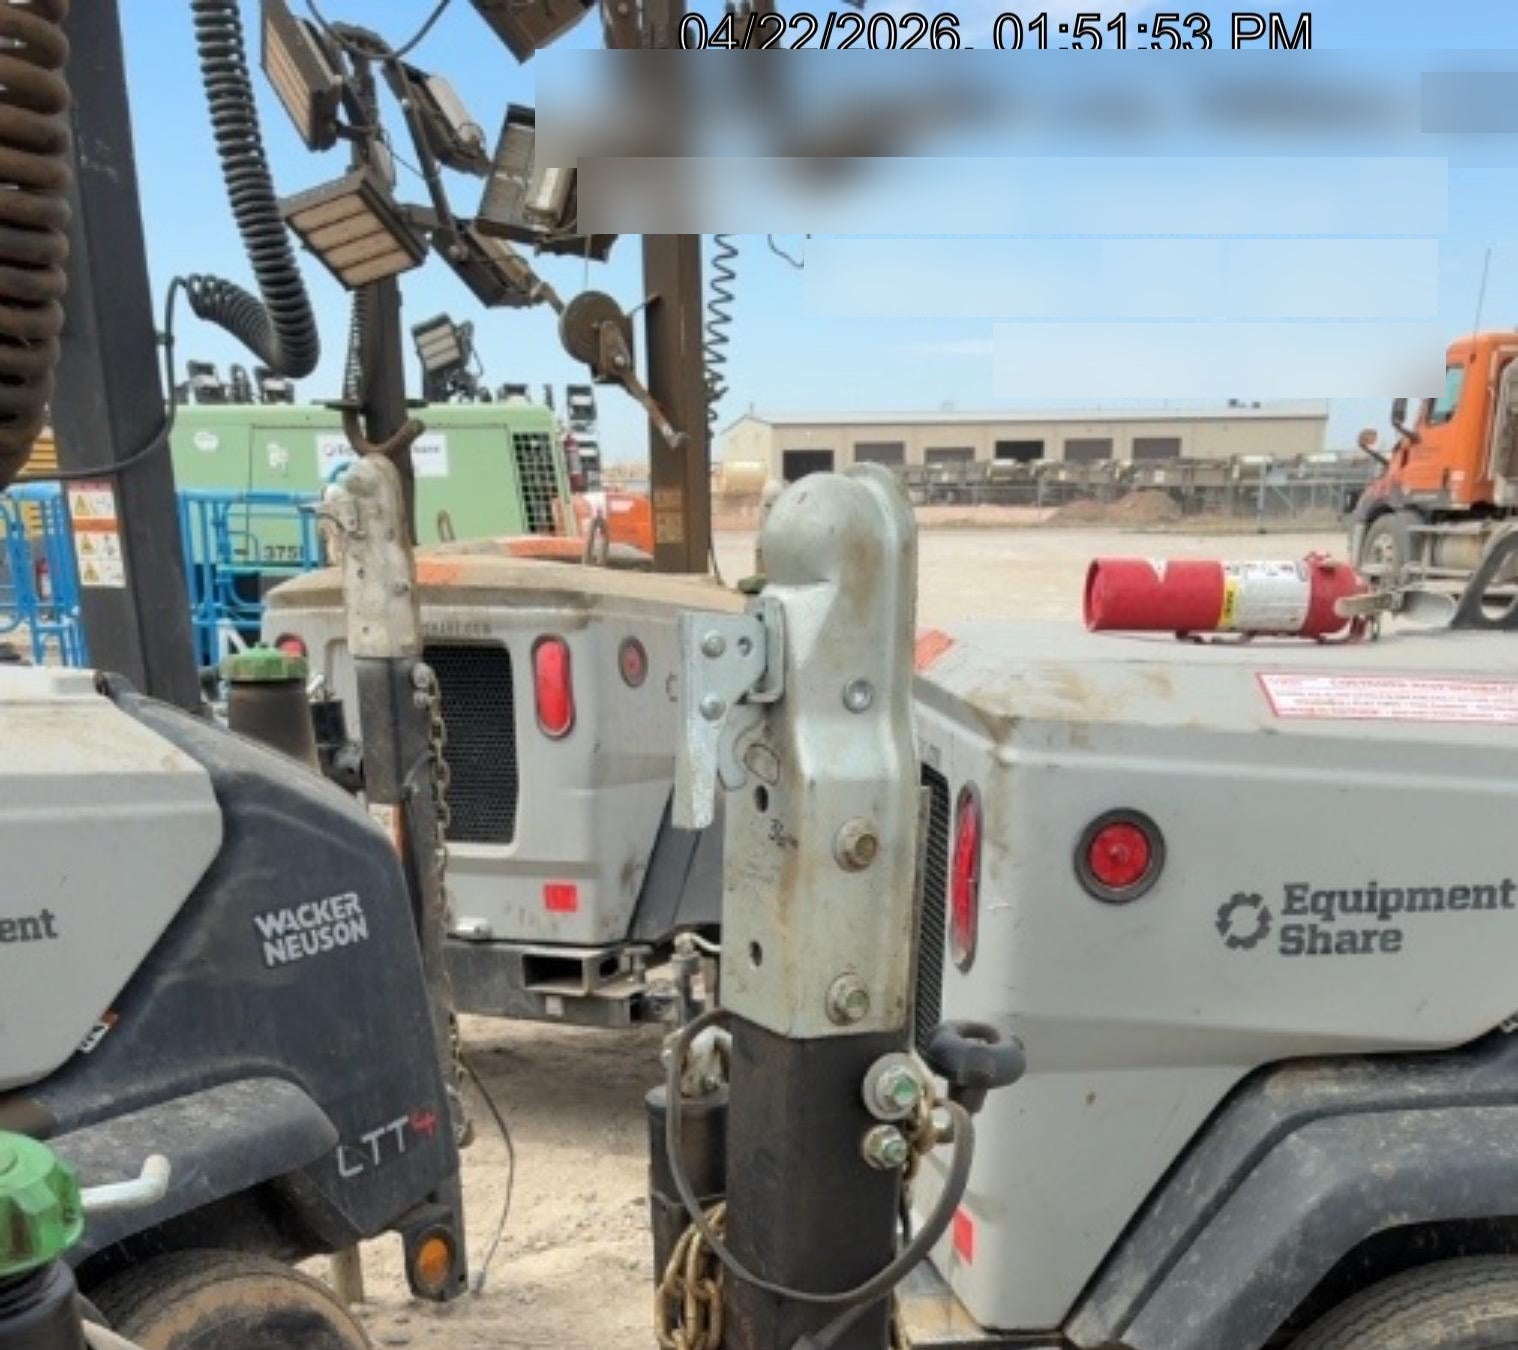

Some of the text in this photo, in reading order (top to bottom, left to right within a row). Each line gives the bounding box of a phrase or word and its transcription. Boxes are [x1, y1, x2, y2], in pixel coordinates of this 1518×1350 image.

[254, 891, 363, 938] WACKER
[1281, 878, 1517, 921] Equipment
[262, 913, 369, 967] NEUSON
[1278, 922, 1404, 956] Share
